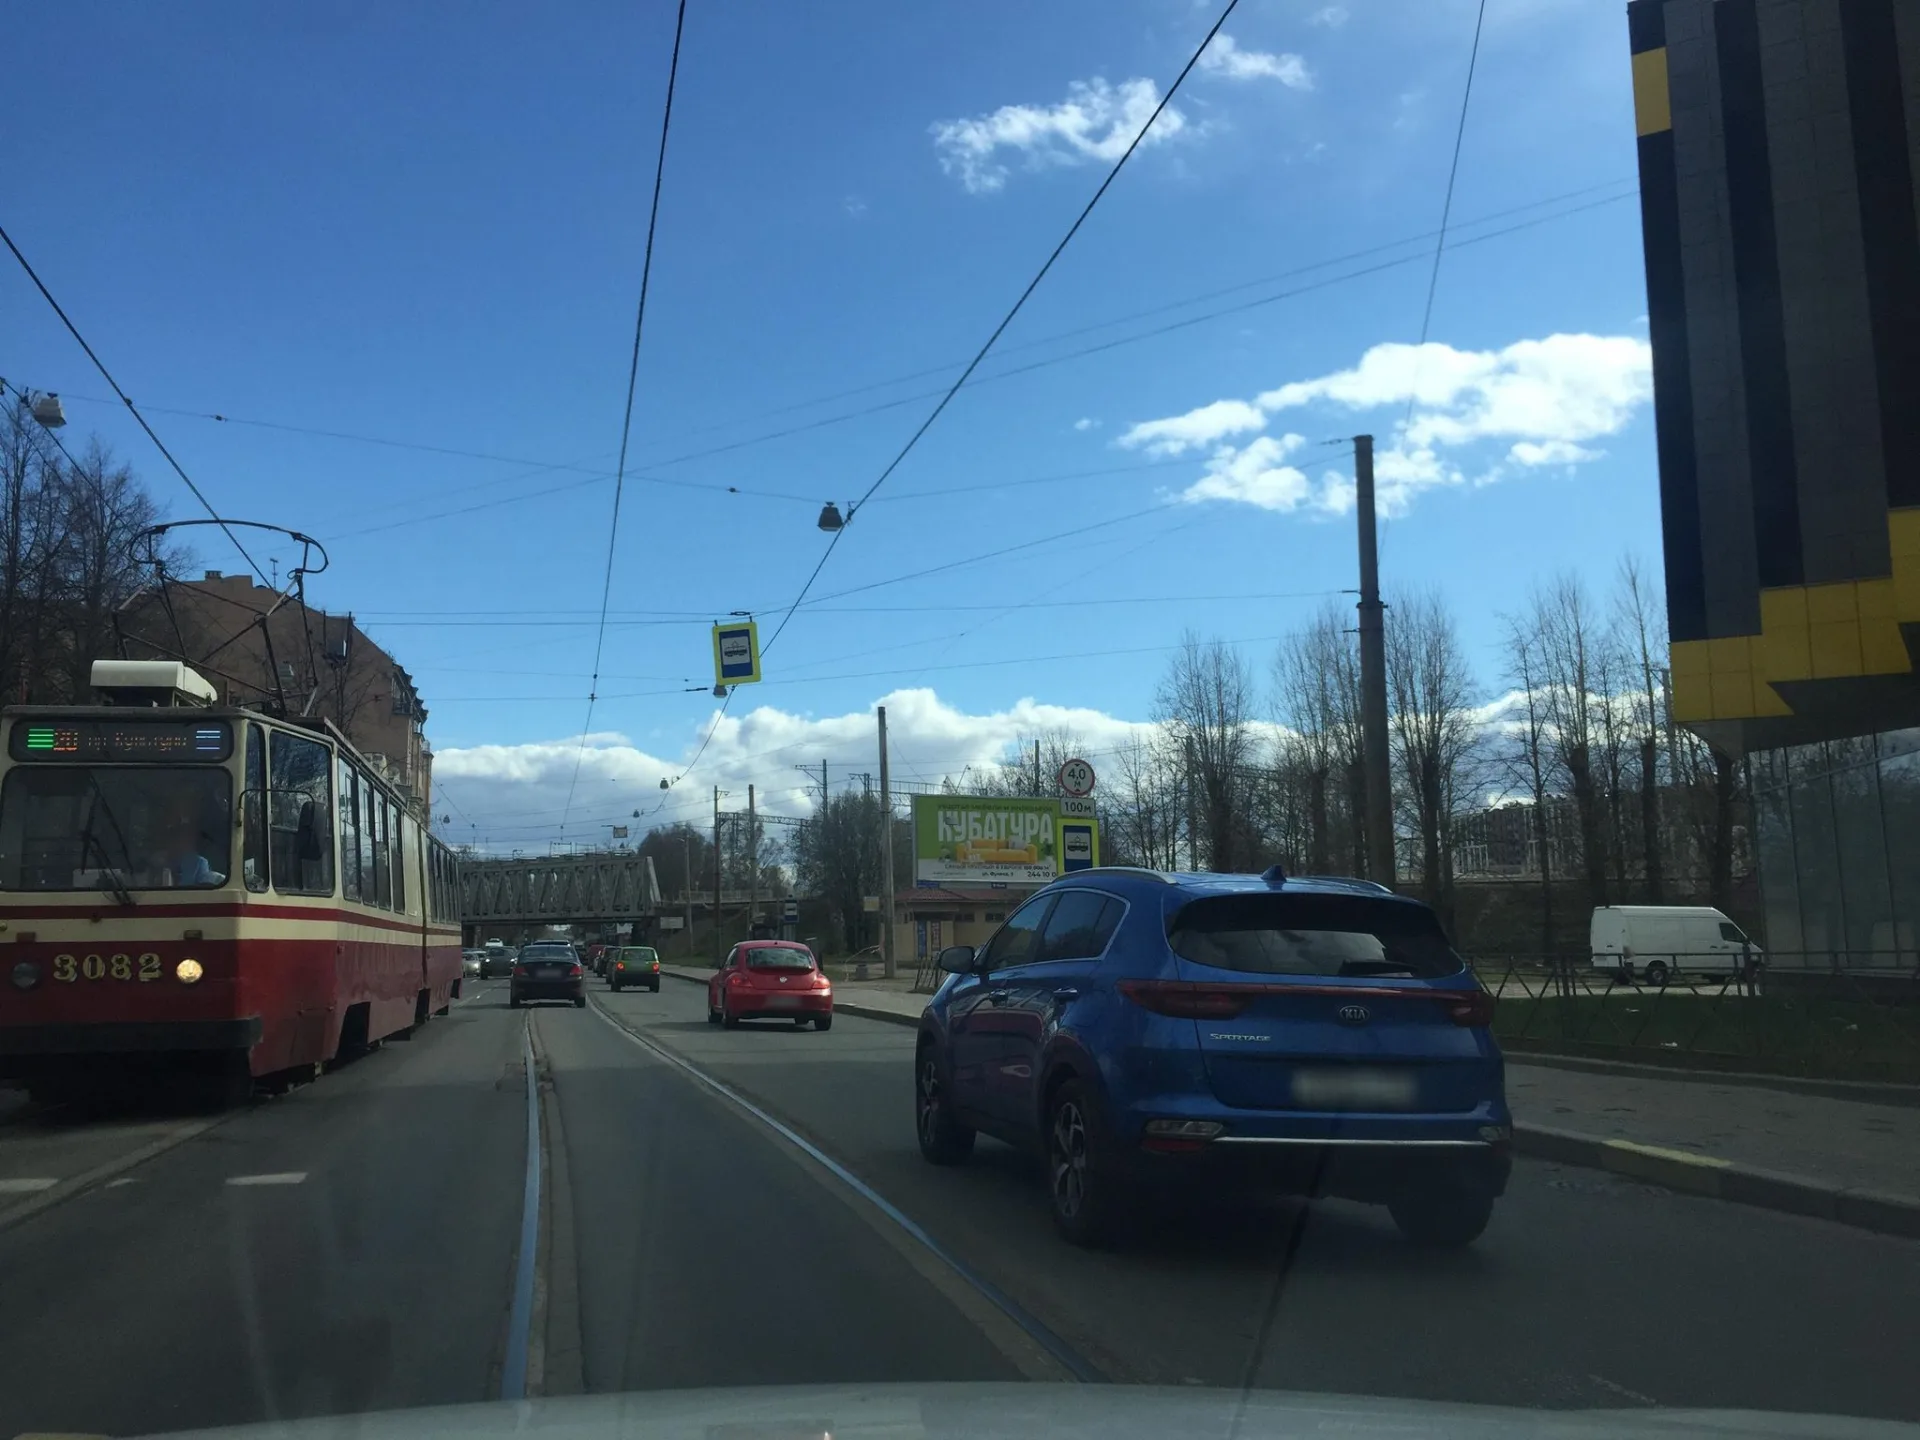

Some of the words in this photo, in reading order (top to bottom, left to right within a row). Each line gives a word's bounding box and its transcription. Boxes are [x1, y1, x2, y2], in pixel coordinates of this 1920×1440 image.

[1067, 768, 1086, 781] 4,0
[937, 810, 1054, 844] КУБАТУРА
[53, 953, 163, 983] 3082
[1344, 1008, 1366, 1020] KIA
[1210, 1033, 1271, 1042] SPORTAGE
